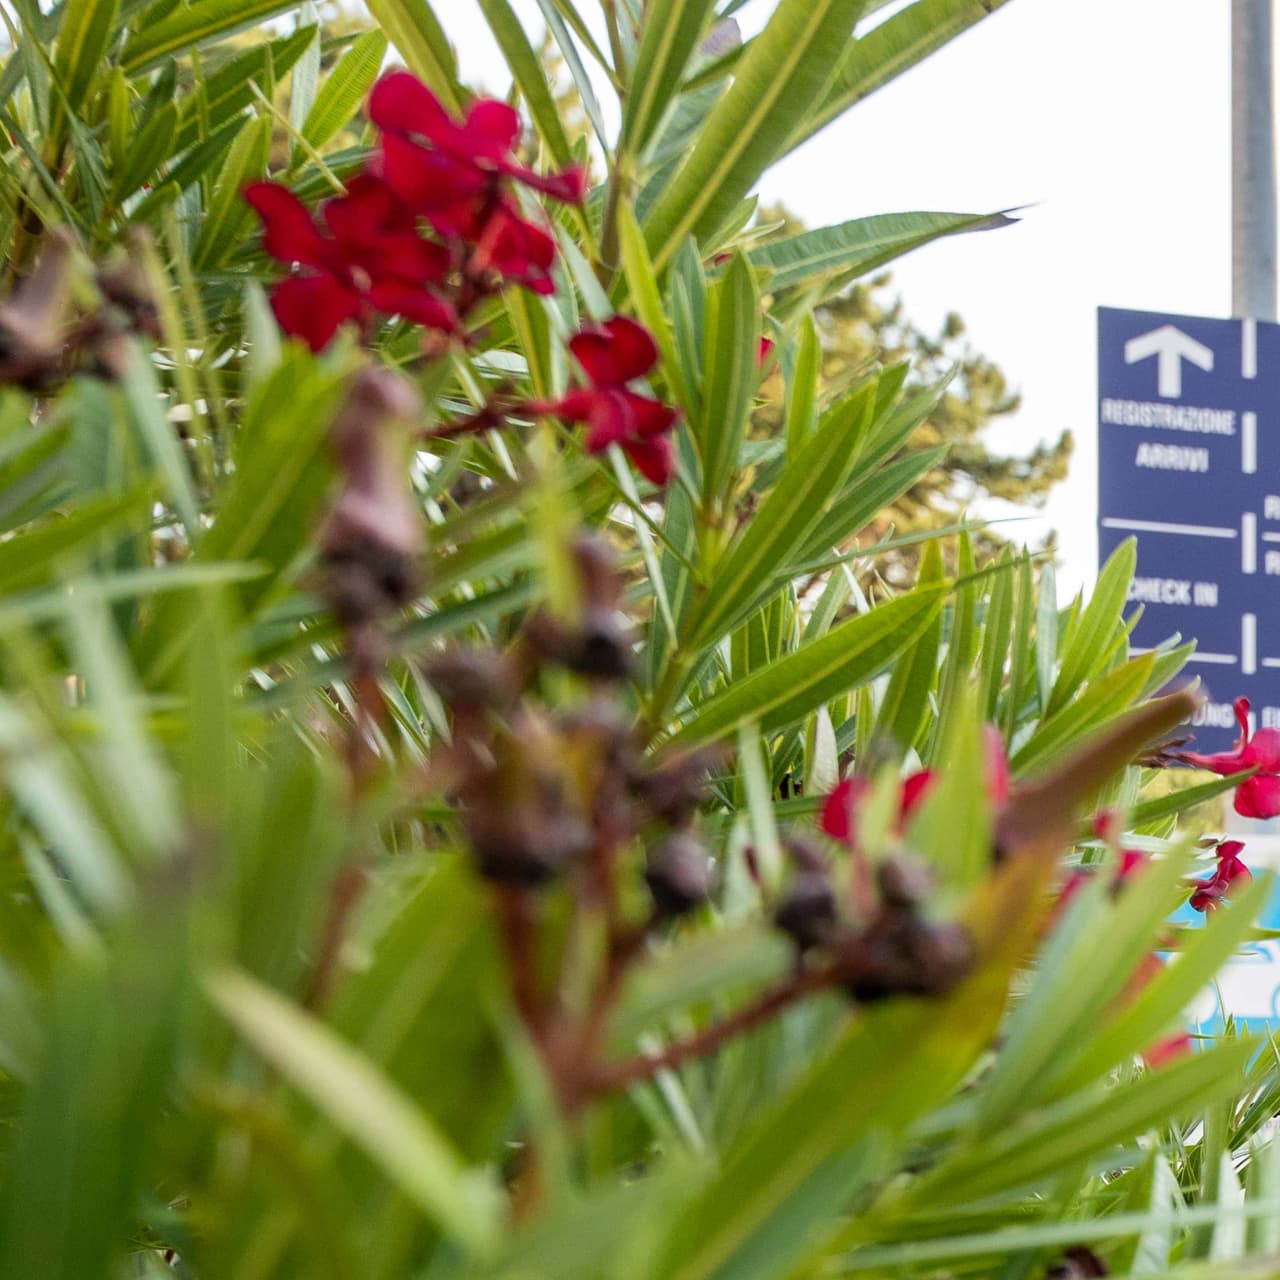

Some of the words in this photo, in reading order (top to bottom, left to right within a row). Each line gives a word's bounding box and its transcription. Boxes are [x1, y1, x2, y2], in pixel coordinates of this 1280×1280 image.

[1101, 398, 1236, 436] REGISTRAZIONE
[1135, 443, 1209, 473] ARRIVI
[1127, 577, 1192, 605] CHECK
[1193, 582, 1219, 607] IN
